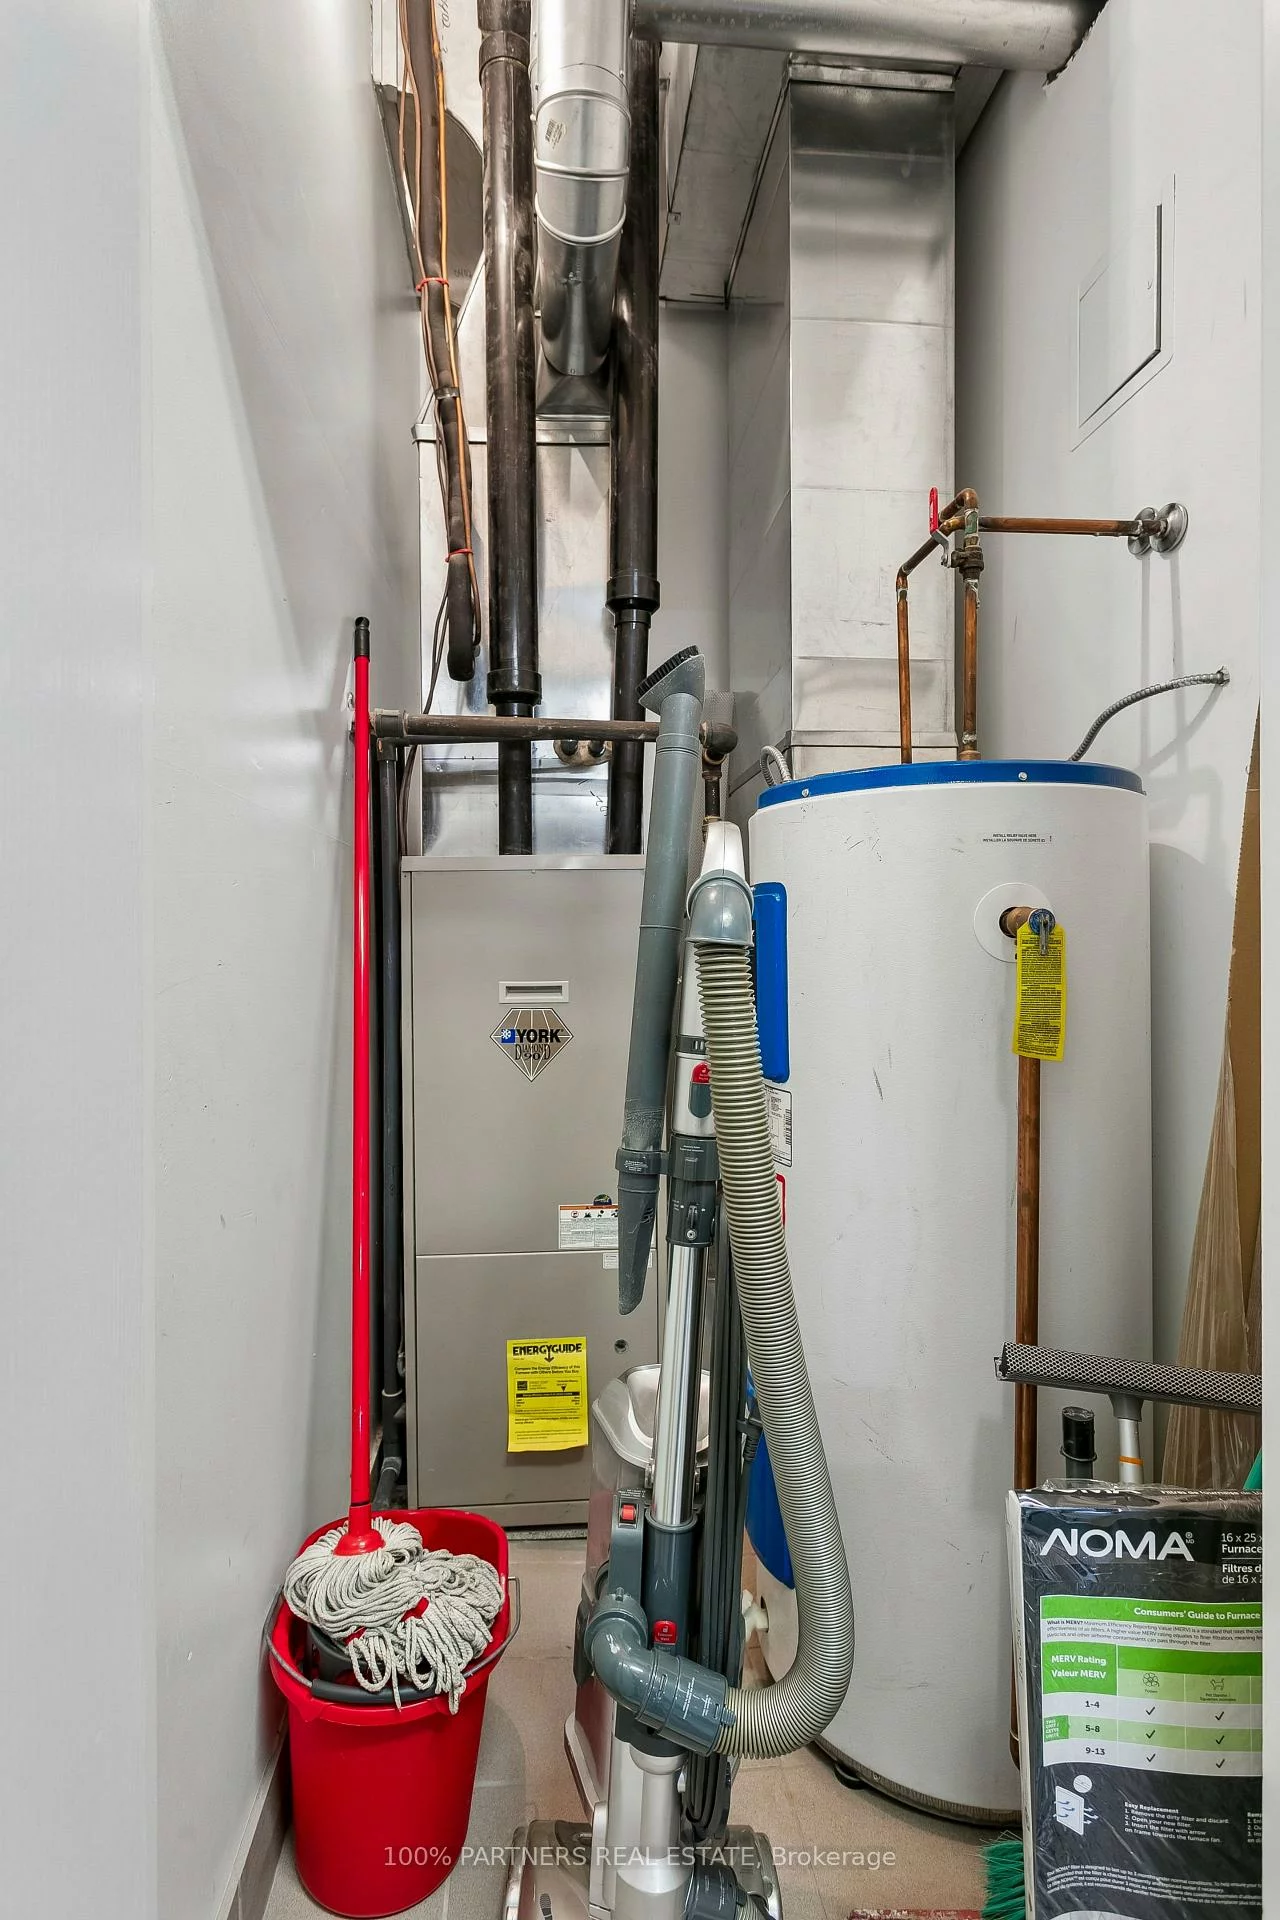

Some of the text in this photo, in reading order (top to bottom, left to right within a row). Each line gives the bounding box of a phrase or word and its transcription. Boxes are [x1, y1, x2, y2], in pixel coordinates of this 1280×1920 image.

[516, 1029, 561, 1043] YORK
[515, 1044, 551, 1060] DIAMOND
[524, 1052, 541, 1060] 90
[512, 1343, 582, 1356] ENERGYGUIDE
[1221, 1533, 1233, 1542] 16
[1244, 1533, 1257, 1542] 25
[1040, 1528, 1194, 1561] NOMA
[1221, 1544, 1262, 1553] Furnace
[1222, 1564, 1252, 1573] Filtres
[1222, 1574, 1235, 1584] de
[1237, 1574, 1249, 1584] 16
[1133, 1607, 1260, 1620] Consumers' Guide to Furnace
[1051, 1654, 1107, 1666] MERV Rating
[1051, 1669, 1106, 1679] Valeur MERV
[1085, 1700, 1100, 1708] 1-4
[1085, 1725, 1100, 1733] 5-8
[1085, 1747, 1105, 1755] 9-13
[1124, 1801, 1179, 1814] Easy Replacement
[1131, 1809, 1154, 1818] Remove
[1131, 1815, 1148, 1824] Open
[1131, 1821, 1148, 1829] Insert
[1133, 1828, 1151, 1837] frame
[1152, 1831, 1176, 1839] towards
